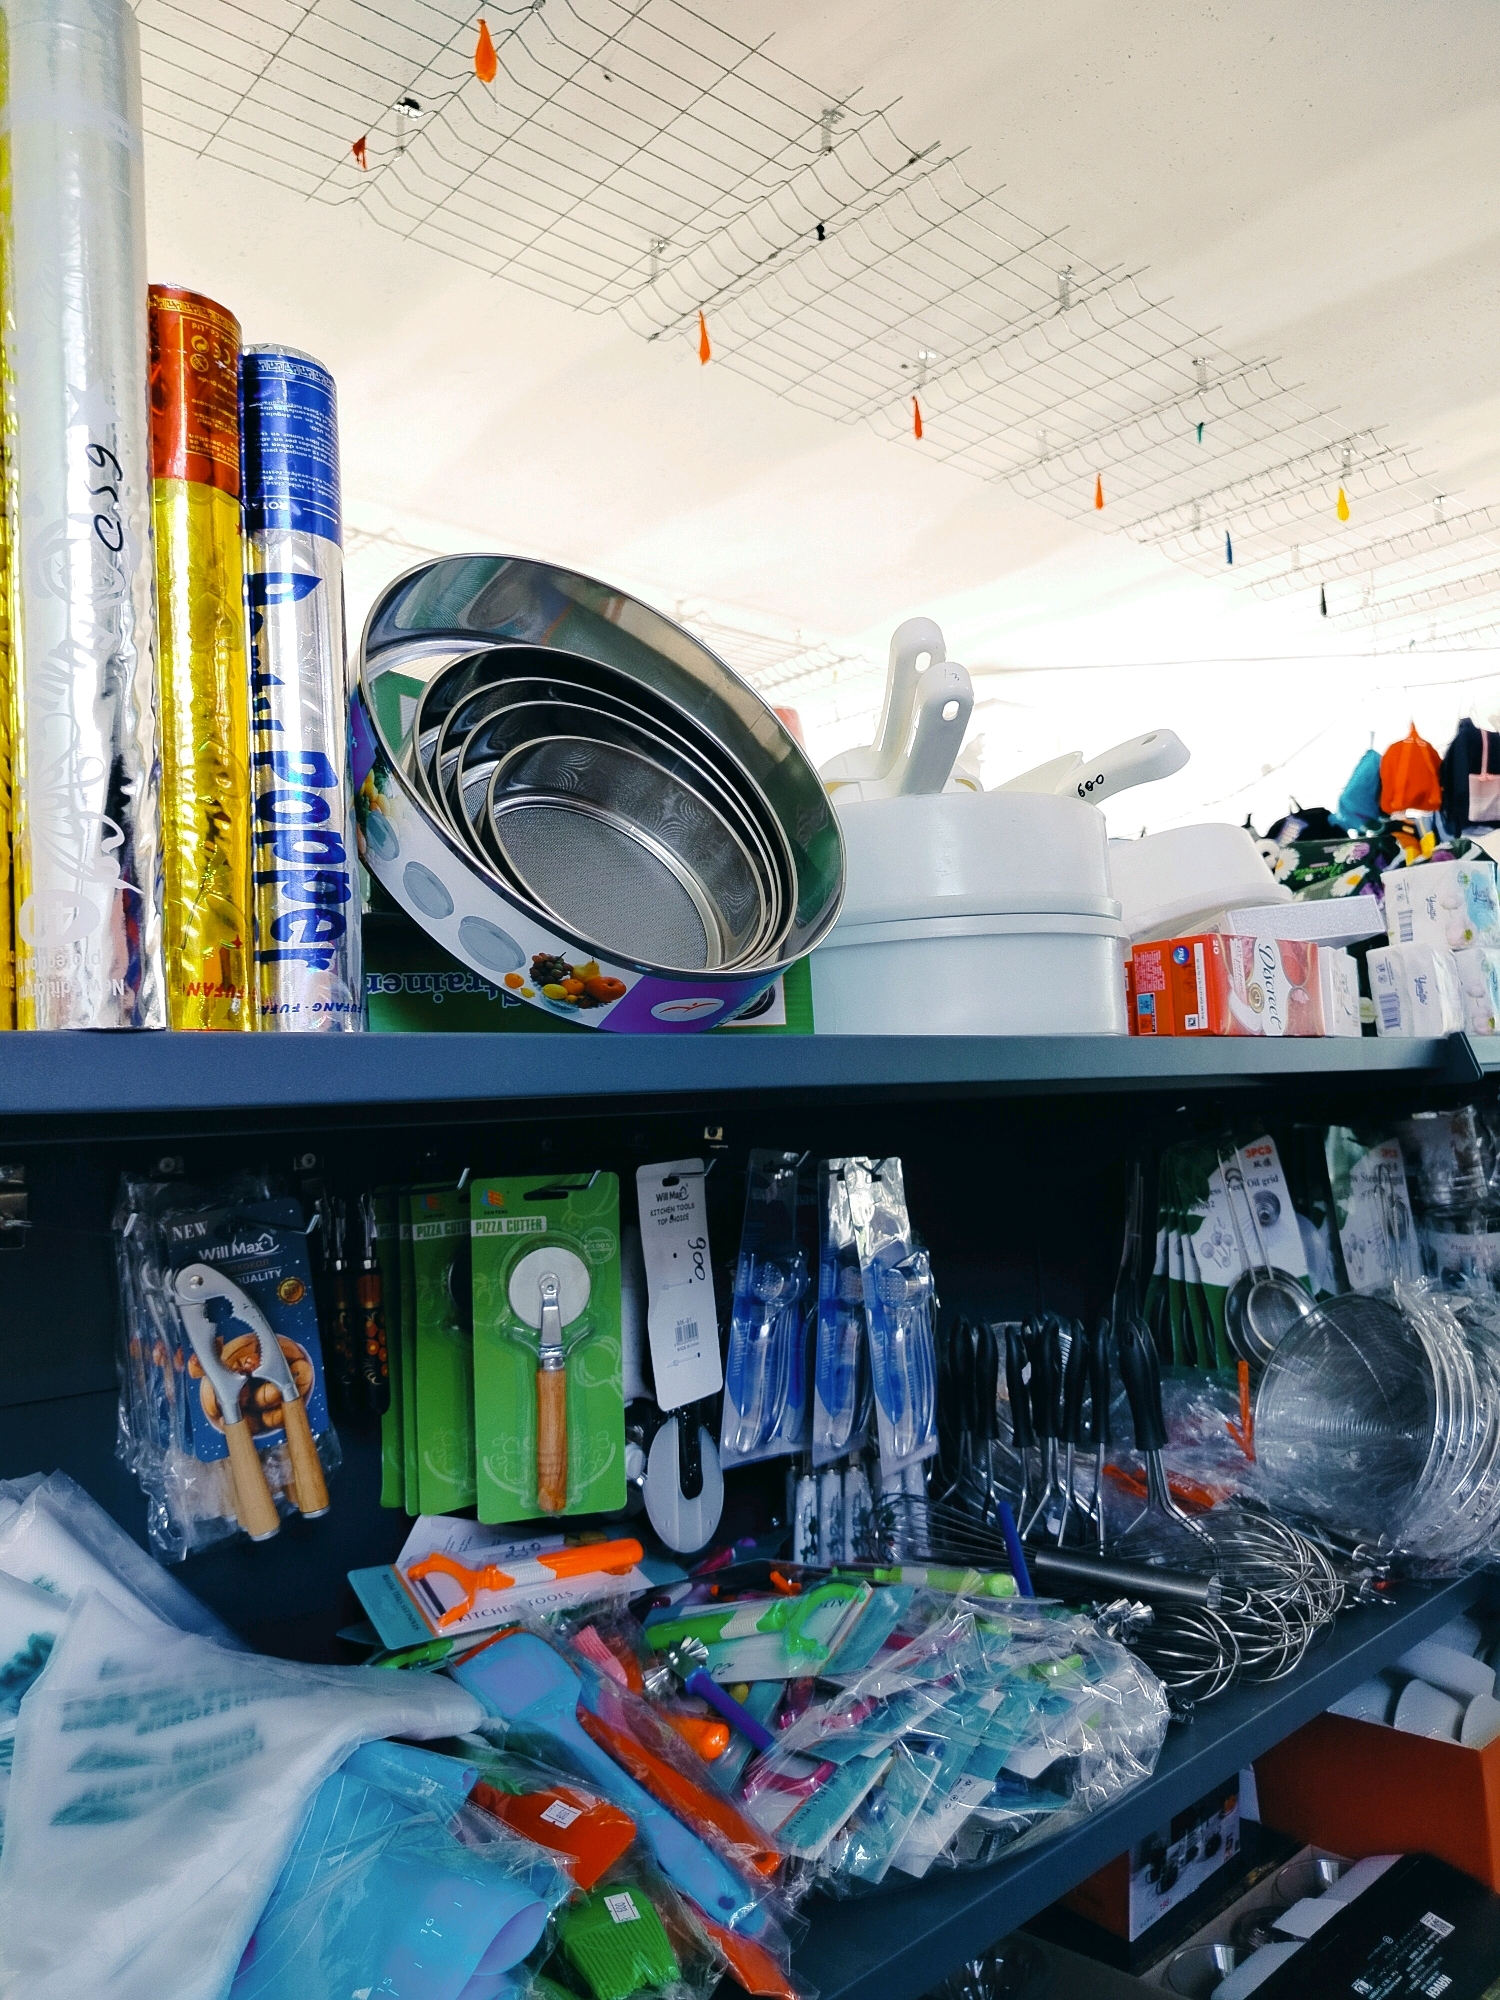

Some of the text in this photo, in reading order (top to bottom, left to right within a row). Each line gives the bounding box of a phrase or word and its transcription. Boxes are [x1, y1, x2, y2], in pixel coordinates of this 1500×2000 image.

[251, 750, 352, 972] Popper
[1258, 943, 1282, 1031] Discreet
[656, 1192, 669, 1202] Will
[650, 1202, 695, 1217] KITCHEN TOOLS
[476, 1218, 543, 1234] PIZZA CUTTER
[658, 1213, 690, 1226] TOP CHOICE
[172, 1220, 208, 1242] NEW
[416, 1224, 442, 1238] PIZZA
[198, 1241, 264, 1260] Will Max
[688, 1237, 706, 1281] 900
[528, 1590, 574, 1607] TOOLS
[420, 1916, 434, 1934] 16
[376, 1974, 394, 1993] 15
[1424, 1973, 1453, 2000] KAVEH
